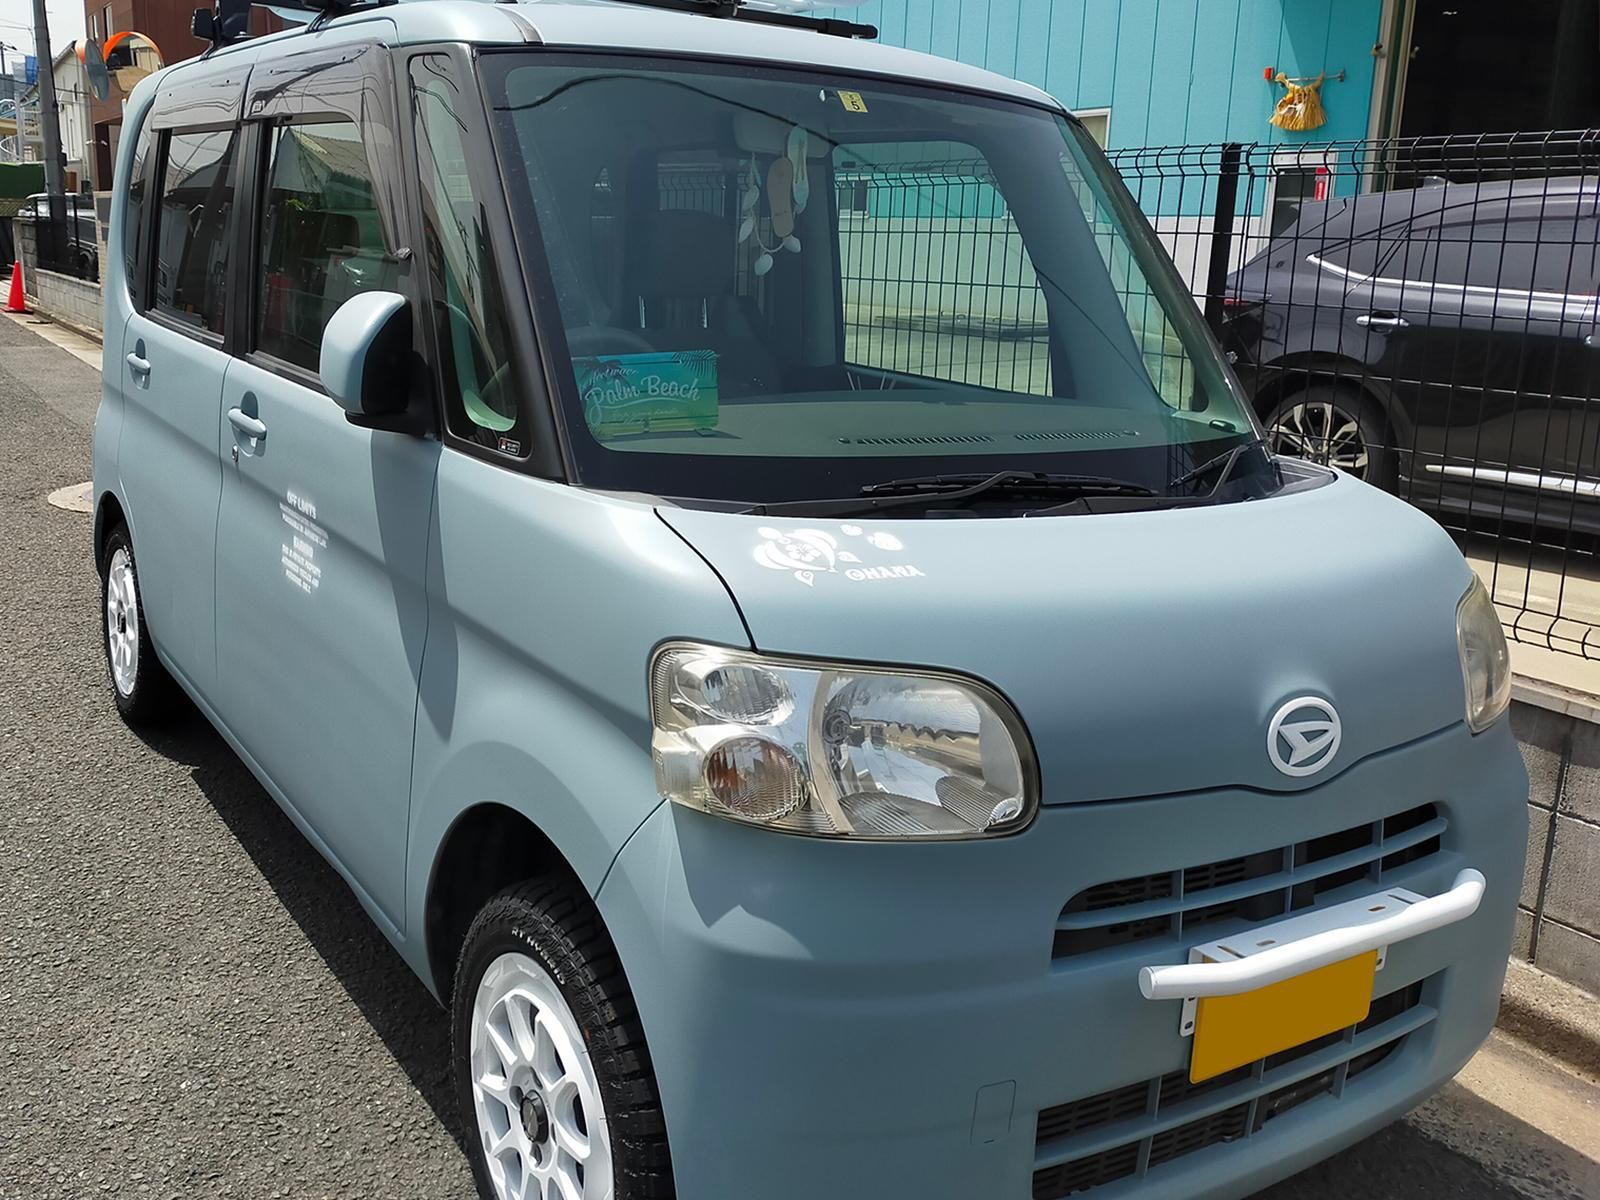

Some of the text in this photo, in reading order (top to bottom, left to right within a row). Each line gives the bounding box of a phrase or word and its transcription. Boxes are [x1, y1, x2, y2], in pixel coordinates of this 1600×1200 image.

[585, 379, 641, 425] Palm
[641, 375, 701, 401] Beach
[286, 490, 297, 506] OFF
[845, 565, 925, 581] OHANA
